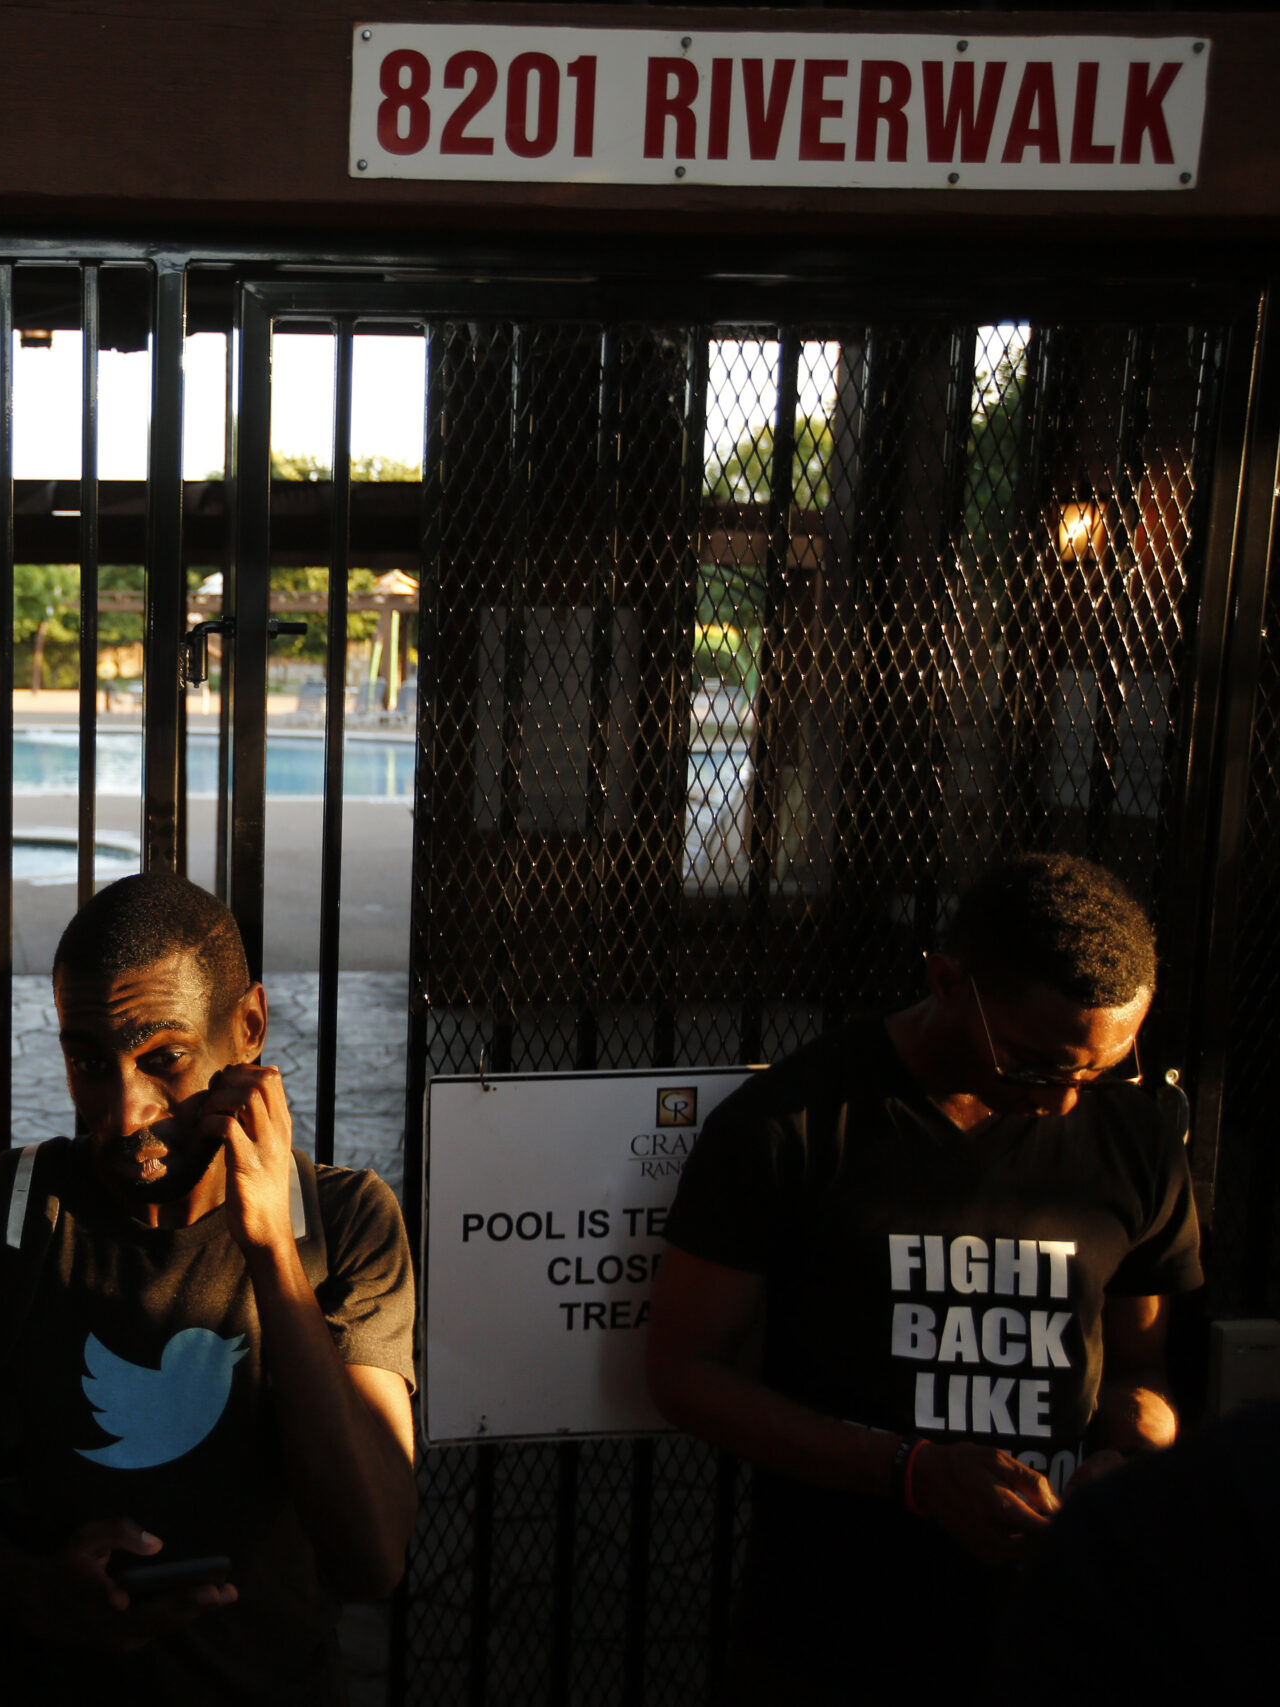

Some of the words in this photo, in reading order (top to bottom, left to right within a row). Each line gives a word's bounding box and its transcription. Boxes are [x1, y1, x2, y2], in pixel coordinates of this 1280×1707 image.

[377, 48, 597, 159] 8201
[643, 56, 1183, 164] RIVERWALK
[462, 1211, 565, 1242] POOL
[578, 1209, 610, 1238] IS
[888, 1233, 1078, 1299] FIGHT
[890, 1302, 1073, 1368] BACK
[914, 1371, 1053, 1438] LIKE
